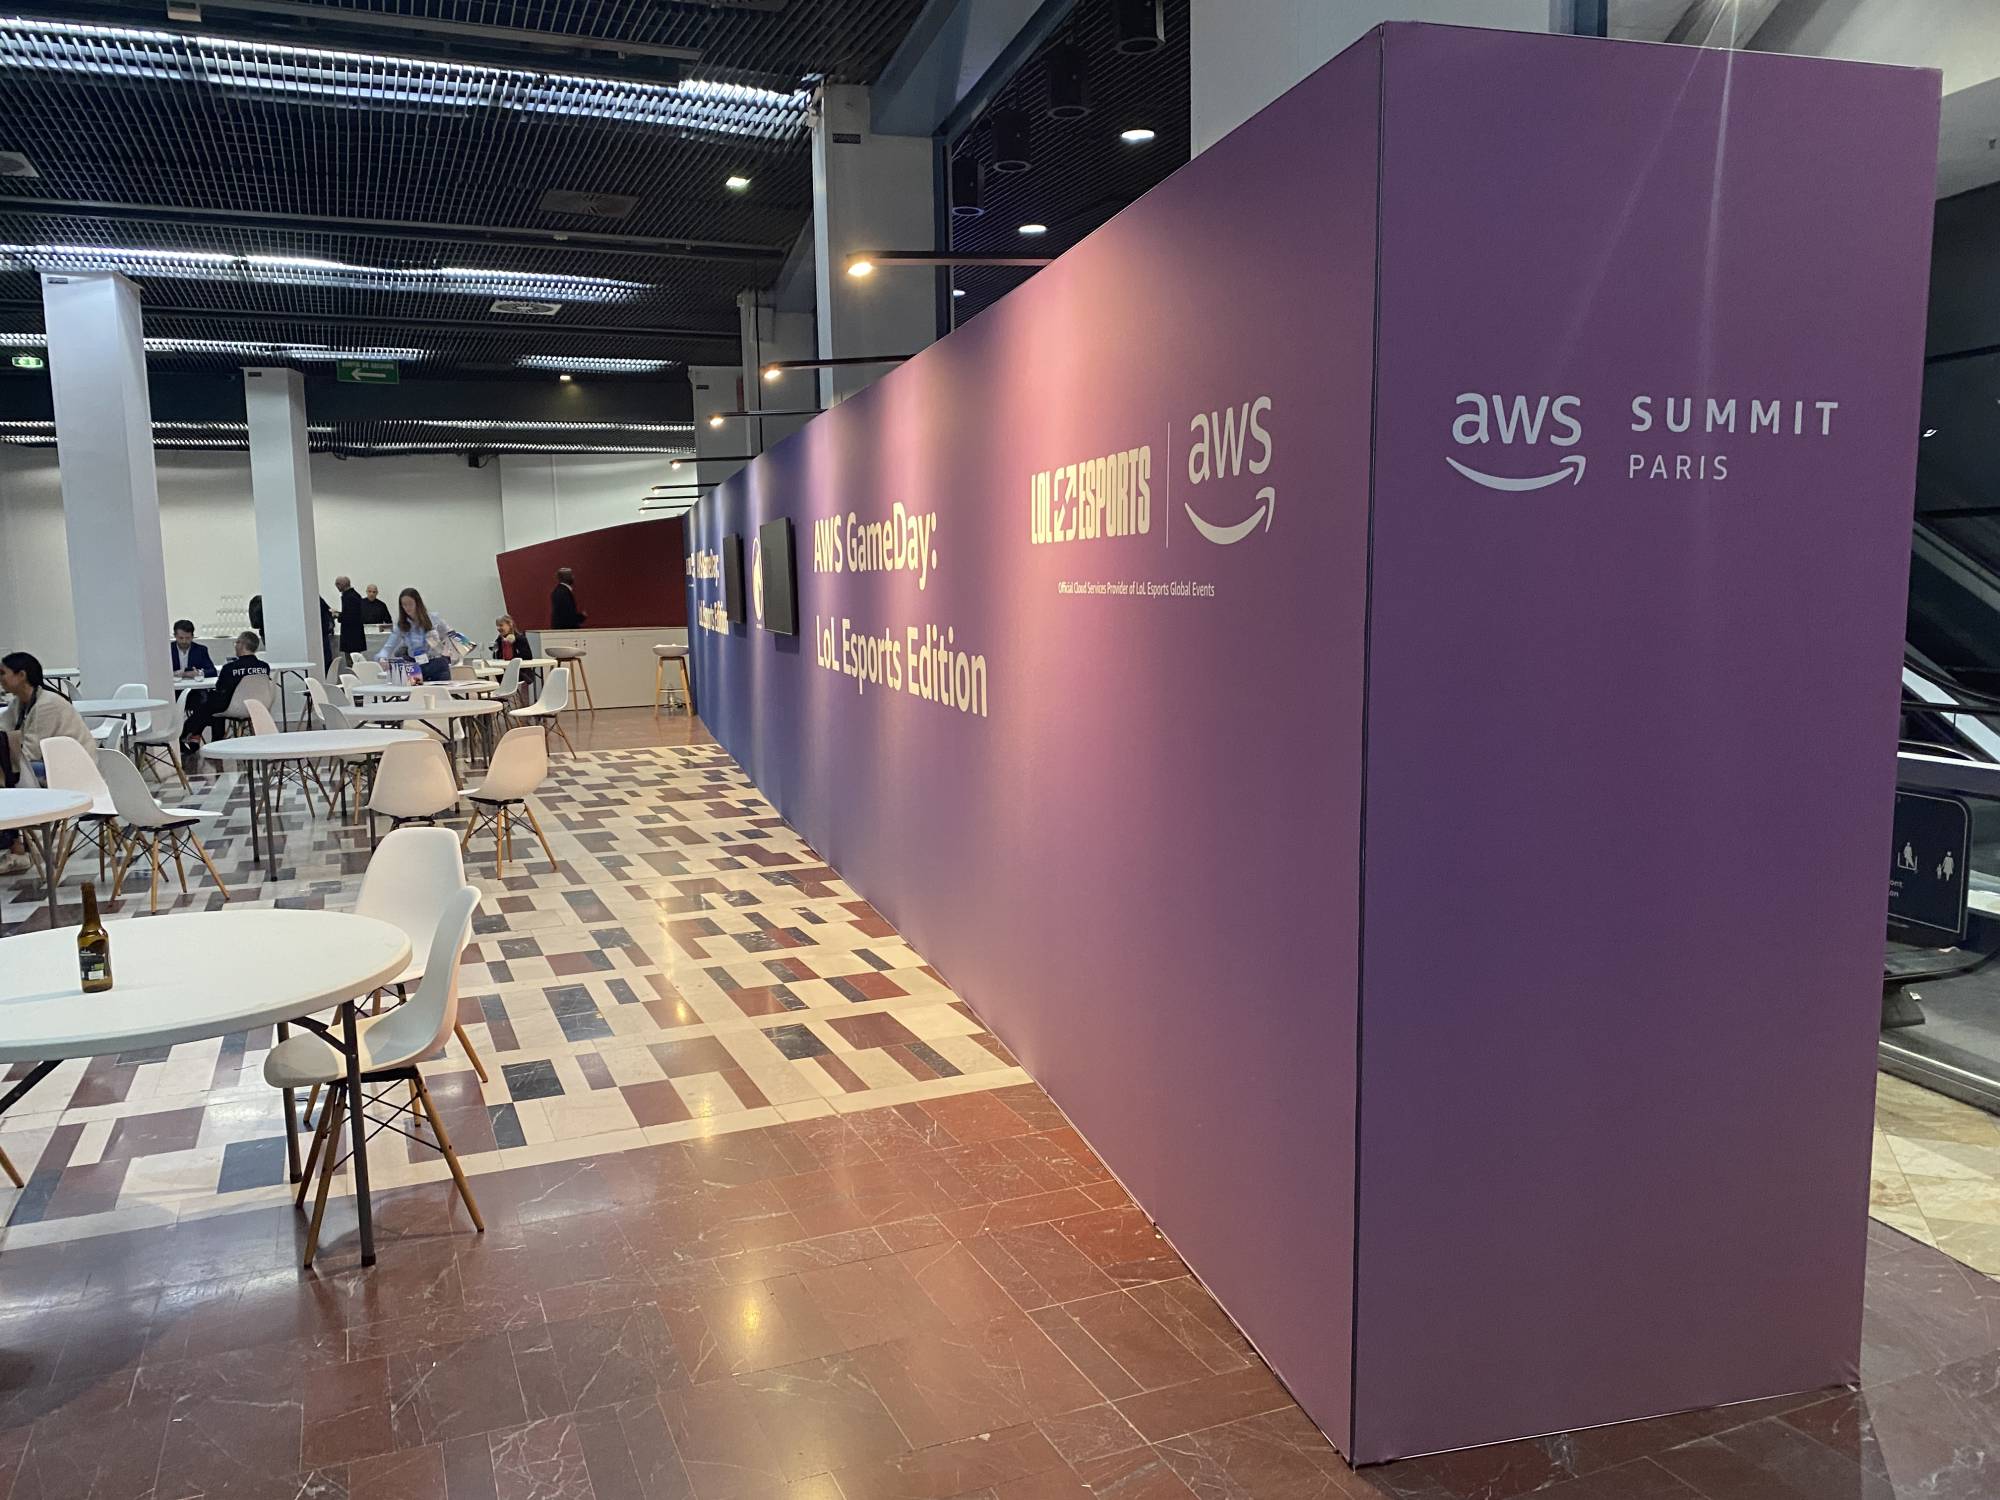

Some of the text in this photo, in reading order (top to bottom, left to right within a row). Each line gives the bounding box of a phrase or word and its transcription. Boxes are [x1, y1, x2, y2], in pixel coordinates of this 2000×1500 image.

[1188, 395, 1272, 484] aws
[1452, 392, 1839, 447] aws SUMMIT
[1079, 445, 1151, 540] ESPORTS
[1629, 454, 1729, 481] PARIS
[814, 501, 937, 591] AWS GameDay:
[1106, 581, 1128, 595] Provider
[1129, 580, 1136, 595] of
[1136, 582, 1146, 595] LoL
[1147, 582, 1169, 598] Esports
[1170, 581, 1191, 597] Global
[1192, 582, 1215, 597] Events
[232, 667, 267, 676] PIT CREW
[816, 615, 840, 671] LoL
[842, 618, 902, 695] Esports
[907, 623, 987, 718] Edition
